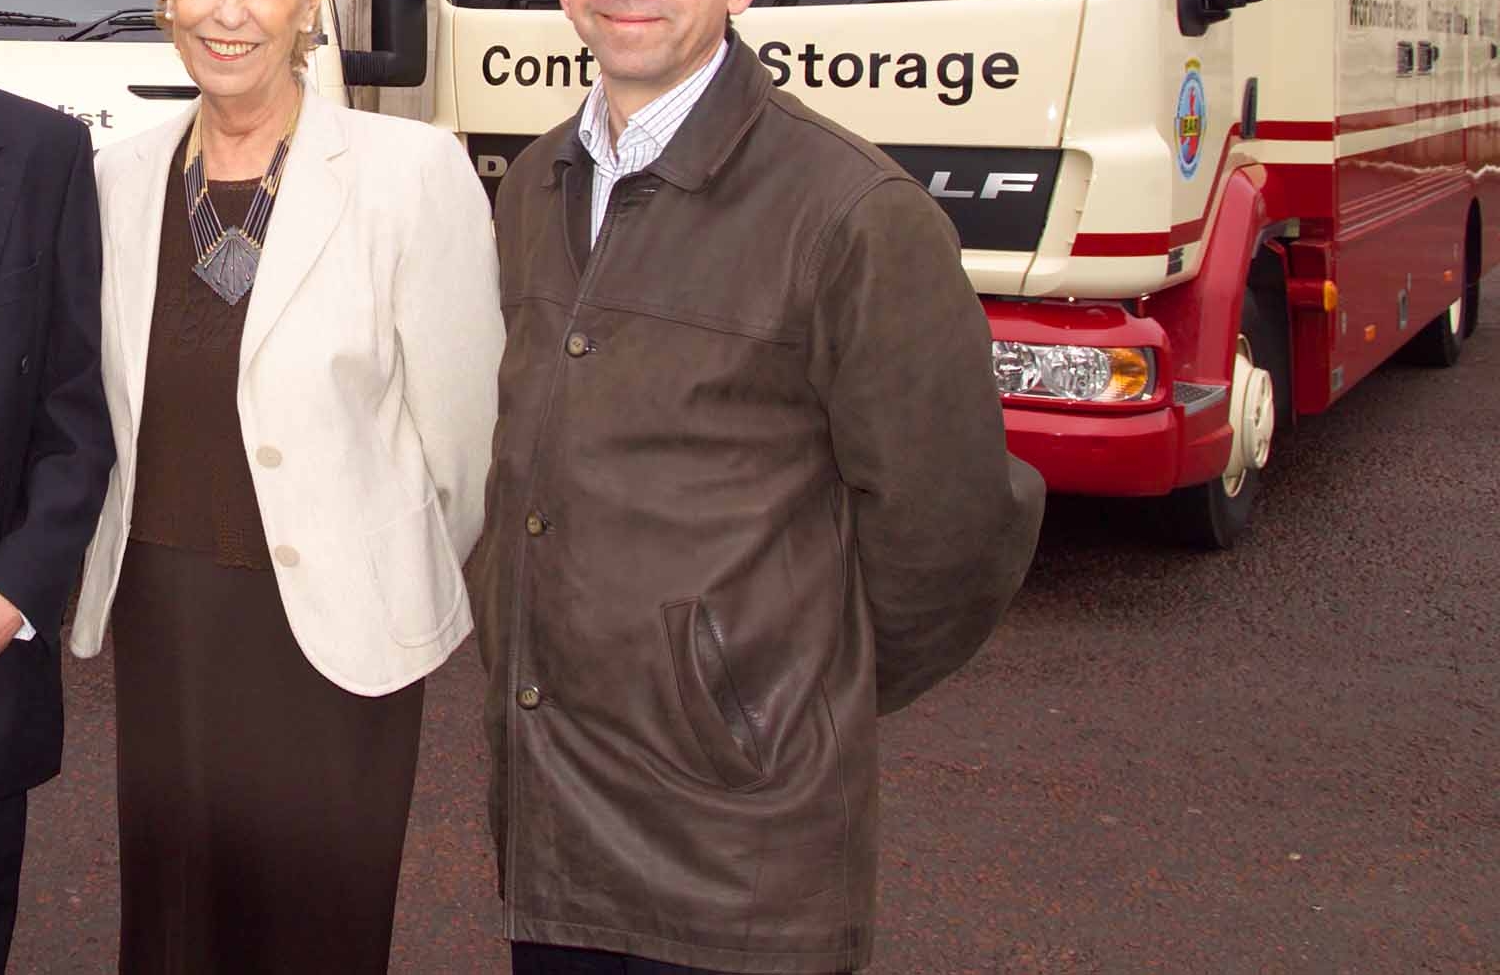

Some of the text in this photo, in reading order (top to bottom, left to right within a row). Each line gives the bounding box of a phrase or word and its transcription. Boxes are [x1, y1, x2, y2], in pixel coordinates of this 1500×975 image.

[482, 40, 1020, 106] Cont Storage
[477, 154, 1040, 200] D LF
